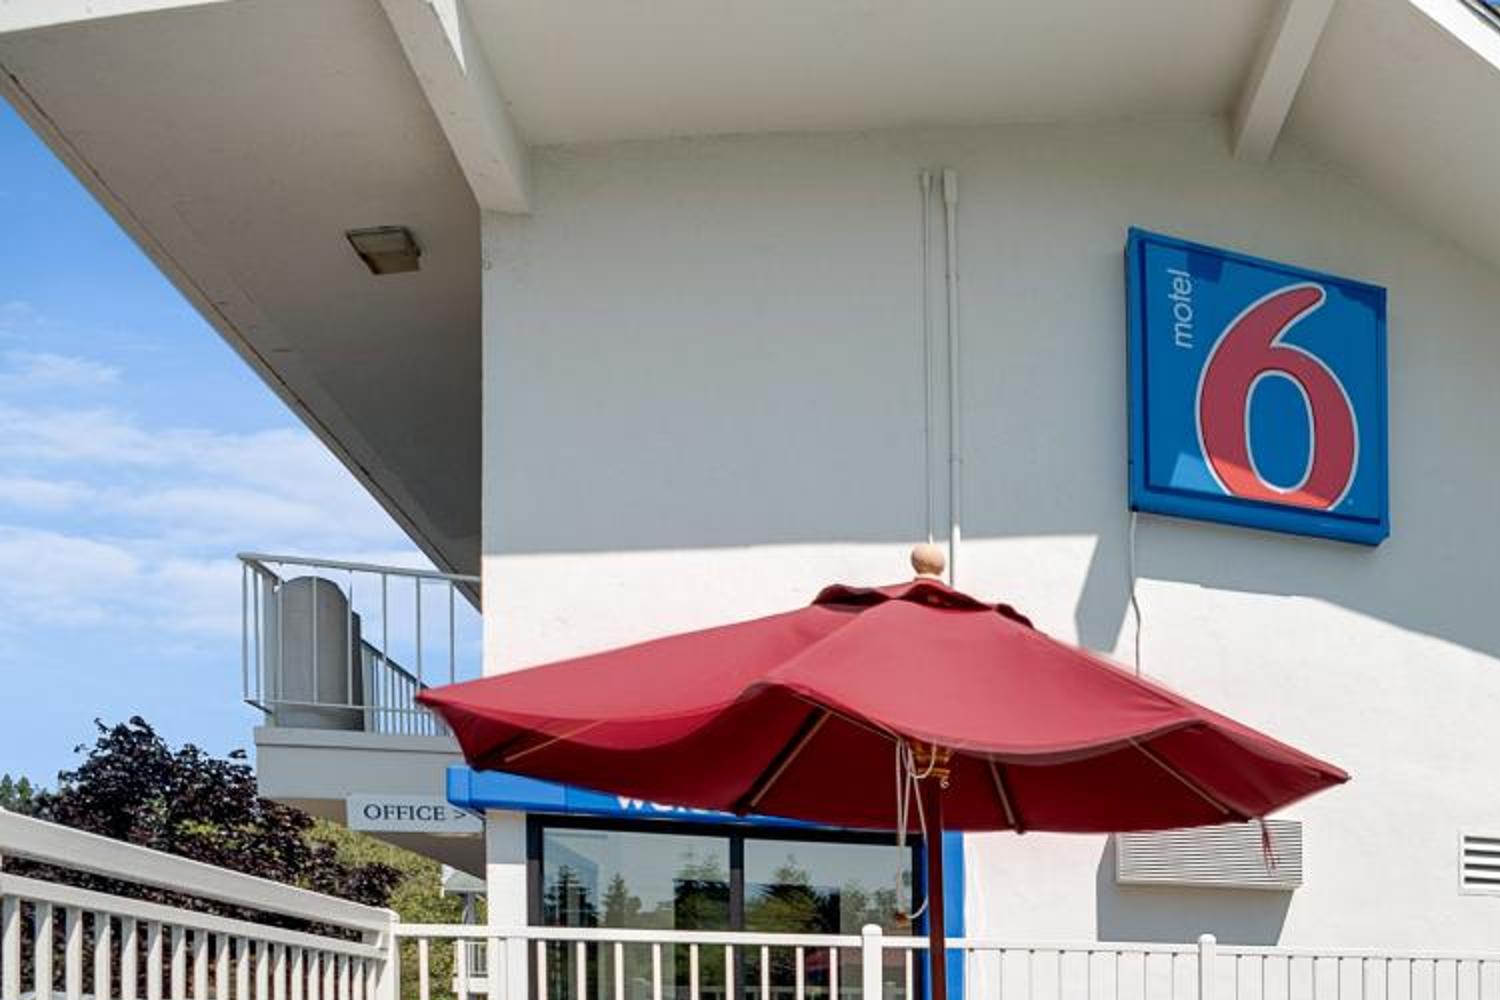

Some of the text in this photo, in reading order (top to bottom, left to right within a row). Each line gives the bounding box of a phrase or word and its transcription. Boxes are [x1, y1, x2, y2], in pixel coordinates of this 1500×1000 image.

[1167, 267, 1193, 349] motel
[1195, 281, 1360, 511] 6
[363, 803, 446, 821] OFFICE
